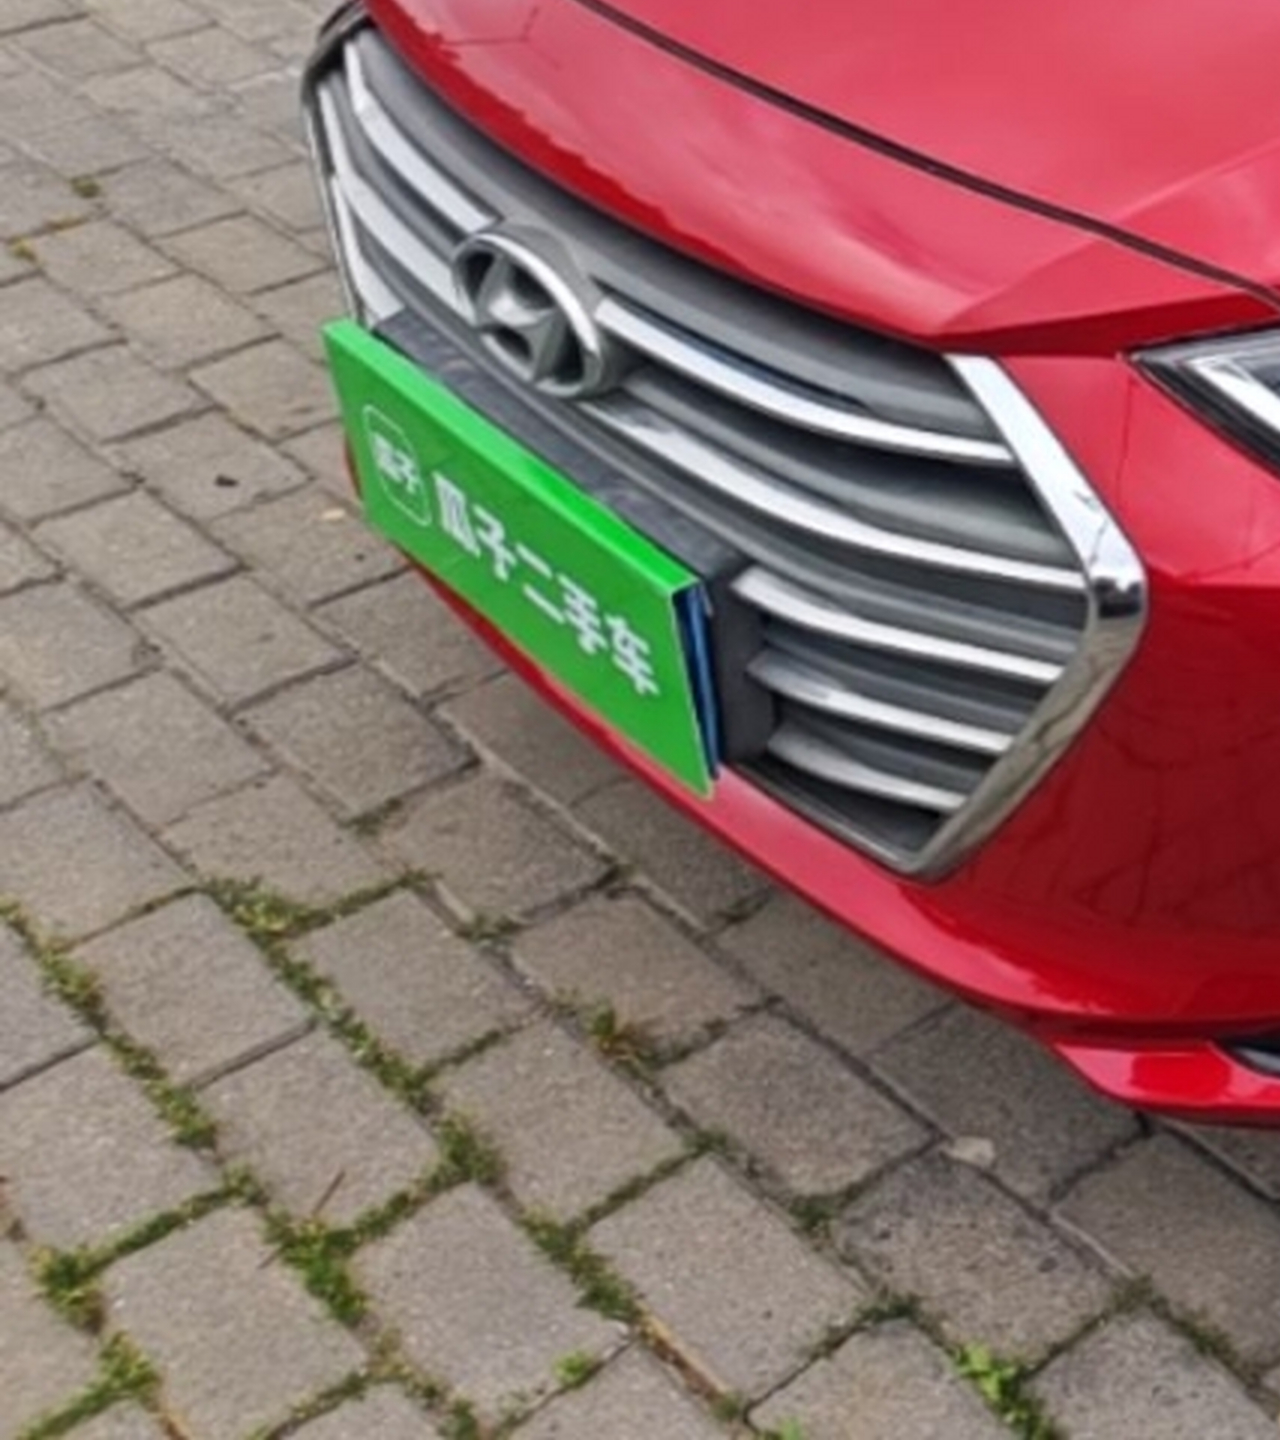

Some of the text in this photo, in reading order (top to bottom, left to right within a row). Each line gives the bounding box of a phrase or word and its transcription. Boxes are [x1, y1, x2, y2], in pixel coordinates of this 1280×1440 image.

[433, 471, 658, 696] 瓜子二手车
